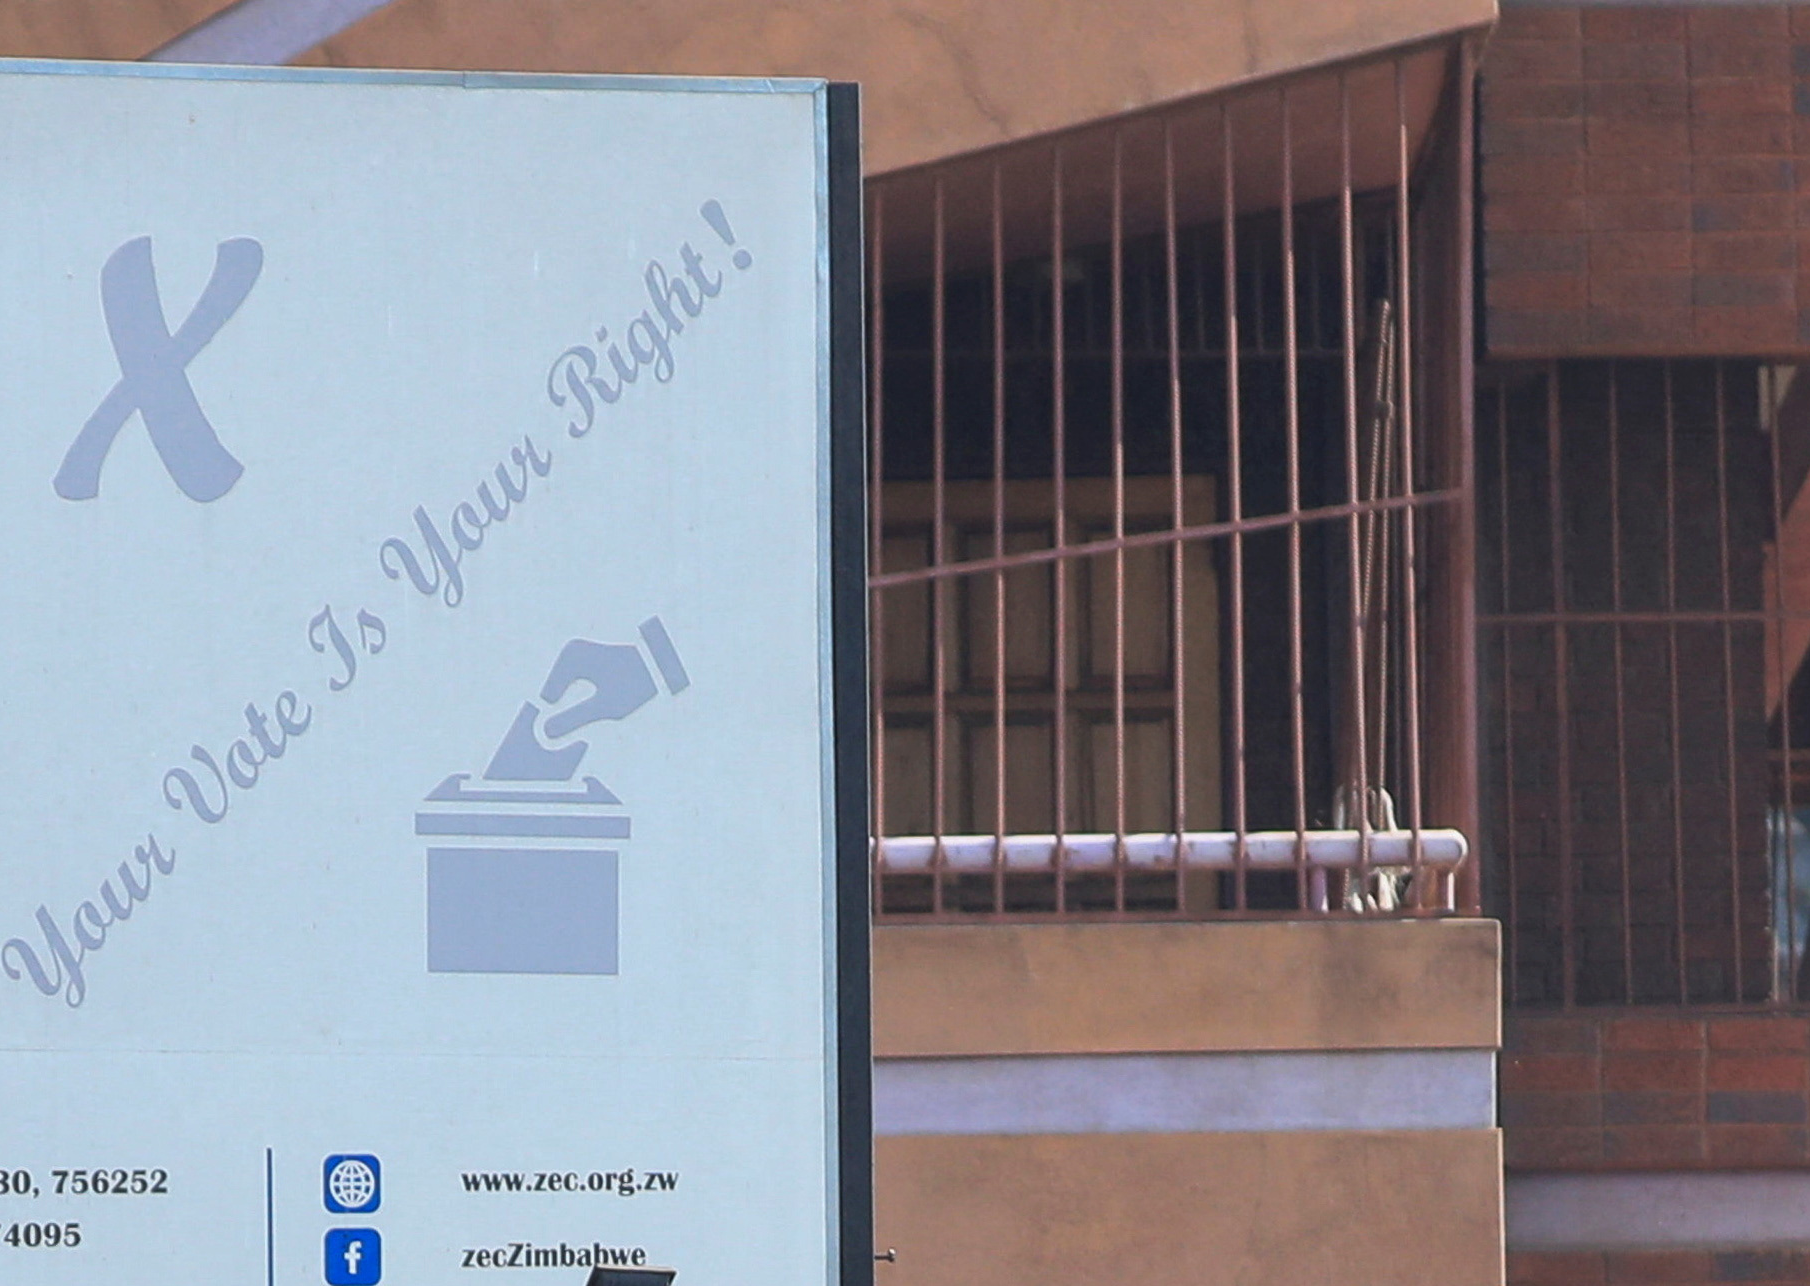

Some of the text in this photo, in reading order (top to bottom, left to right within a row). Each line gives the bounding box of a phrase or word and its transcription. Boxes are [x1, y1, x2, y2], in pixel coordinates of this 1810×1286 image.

[0, 197, 753, 1009] Your Vote Is Your Right!
[51, 1169, 168, 1194] 756252
[461, 1168, 678, 1197] www.zec.org.zw
[461, 1242, 646, 1267] zecZimbabwe
